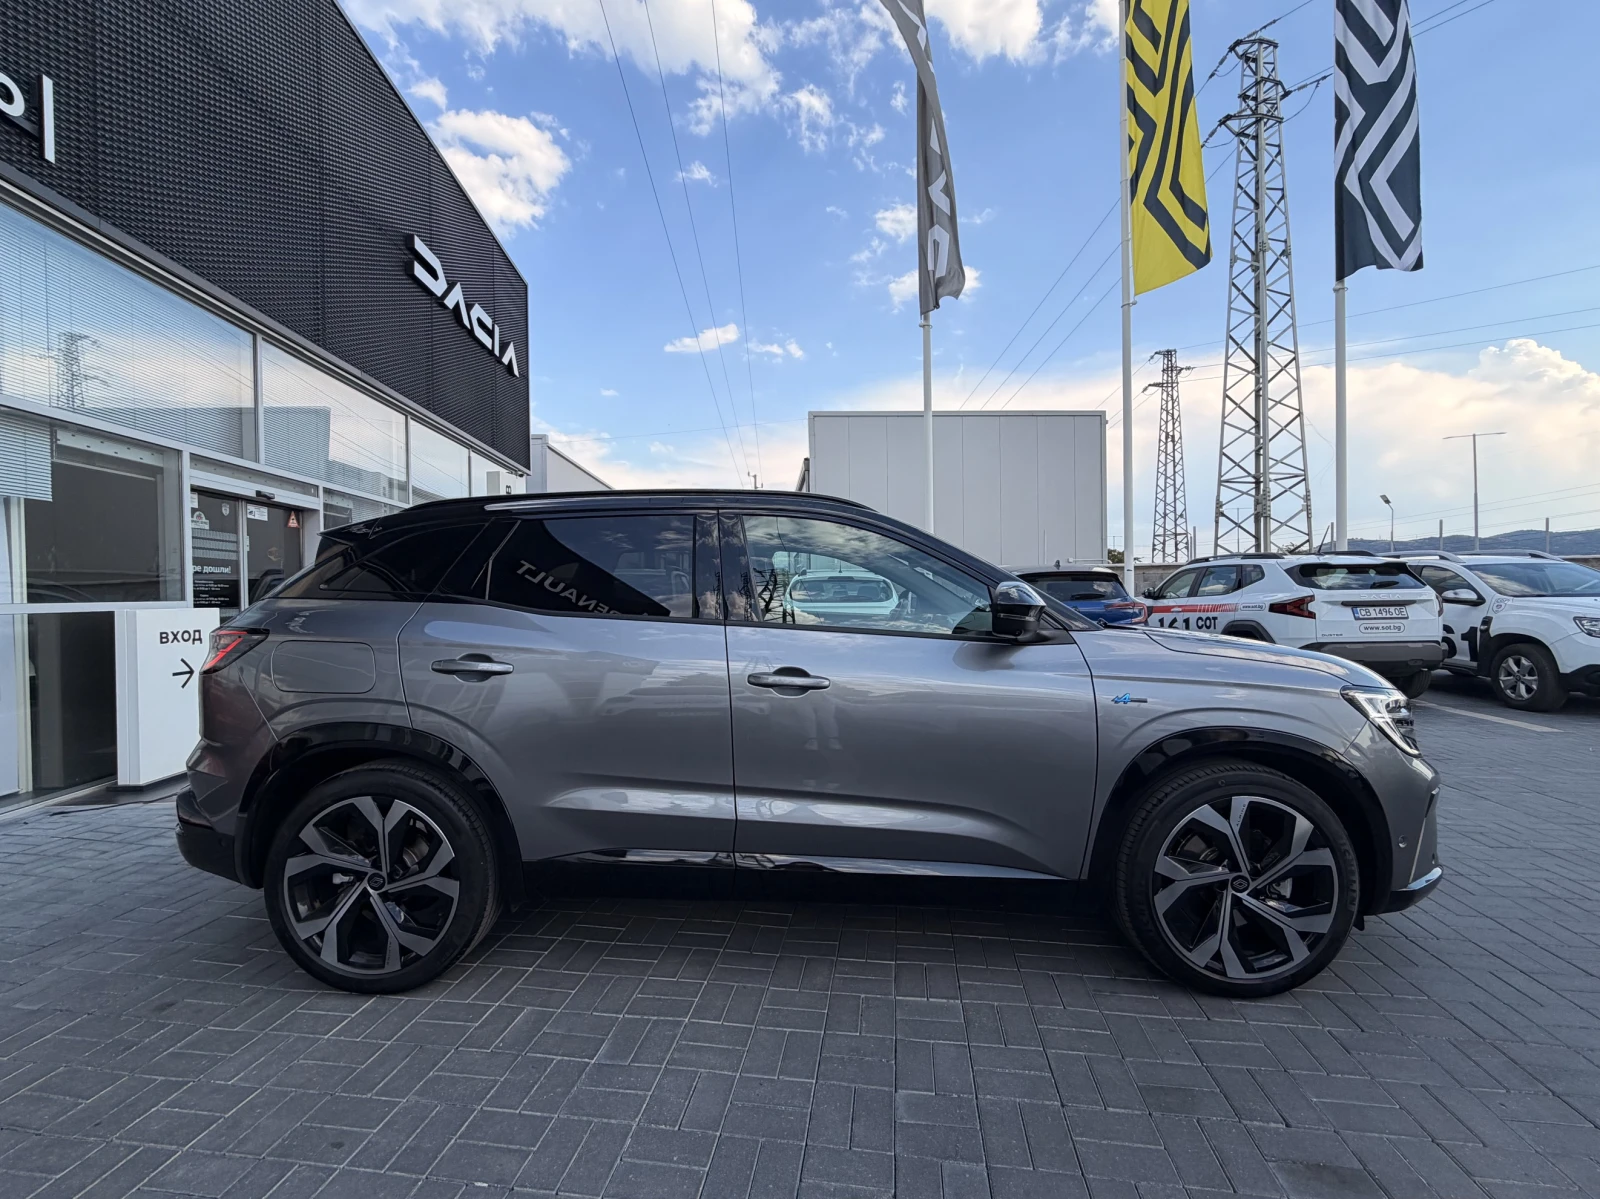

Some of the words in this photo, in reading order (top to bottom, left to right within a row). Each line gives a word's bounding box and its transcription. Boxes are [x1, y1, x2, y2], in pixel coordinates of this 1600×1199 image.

[412, 234, 519, 378] DACIA
[1373, 607, 1394, 617] 1496
[1363, 624, 1402, 632] www.sot.bg
[159, 628, 203, 645] ВХОД
